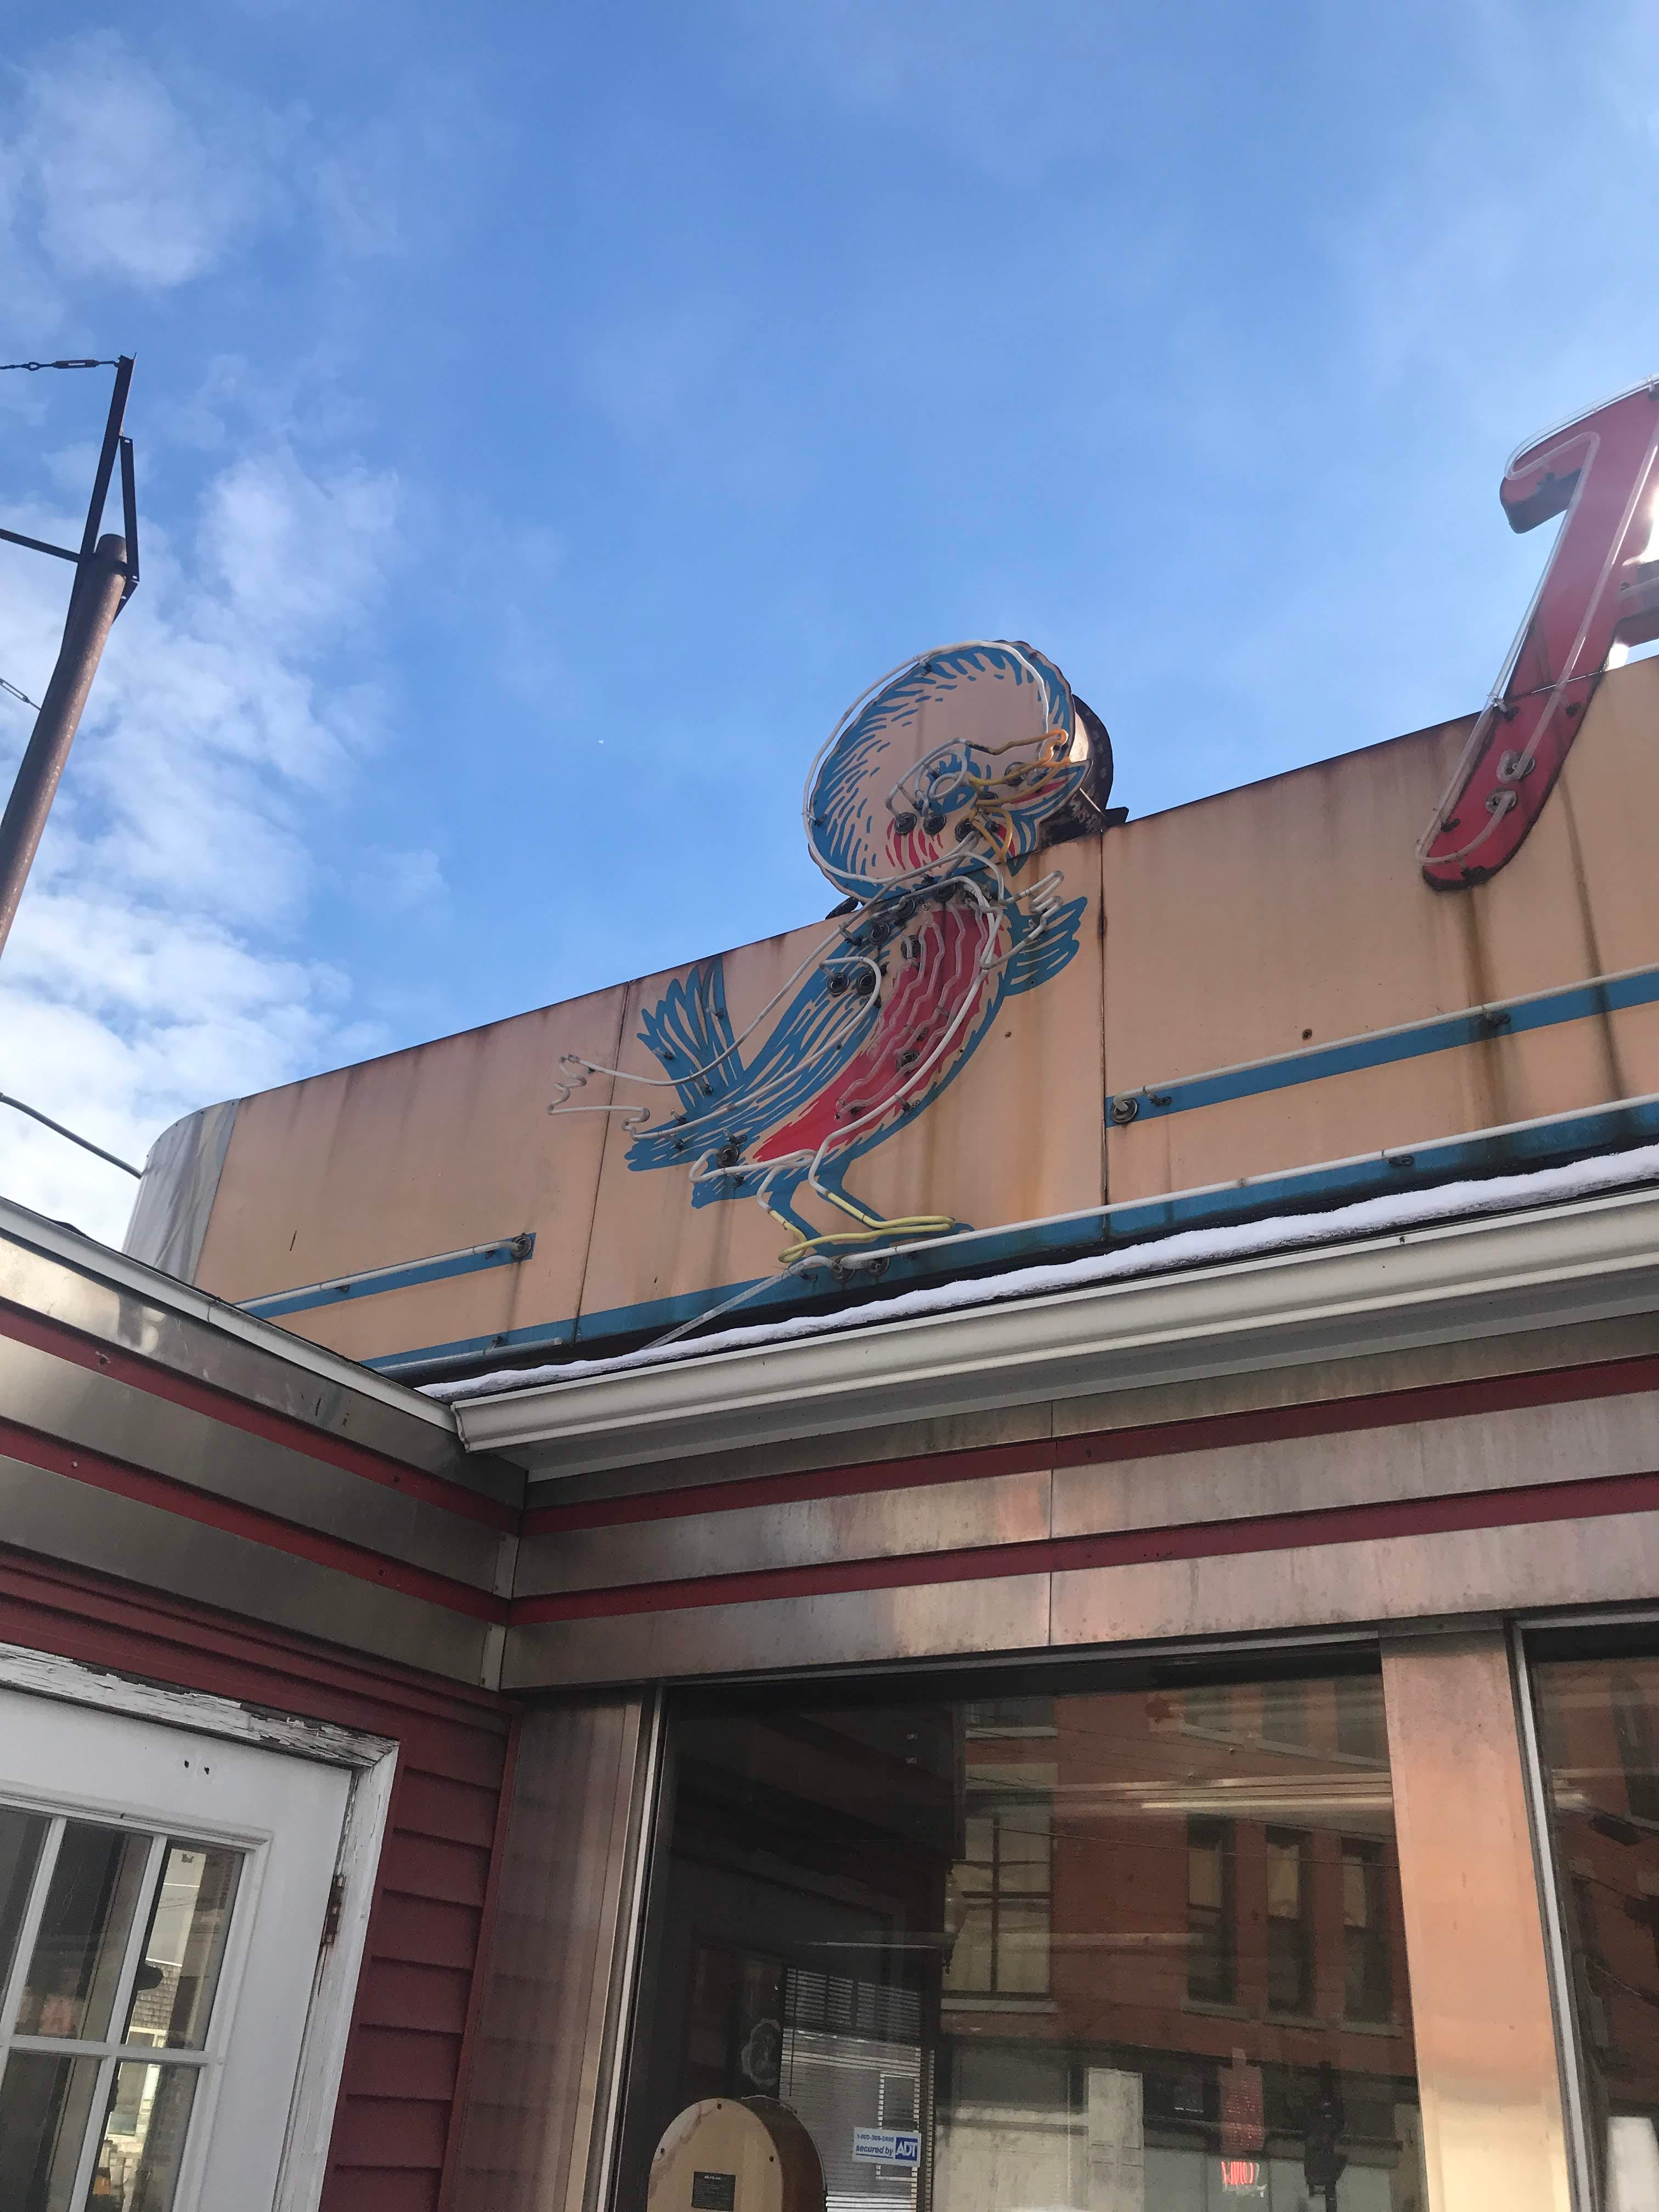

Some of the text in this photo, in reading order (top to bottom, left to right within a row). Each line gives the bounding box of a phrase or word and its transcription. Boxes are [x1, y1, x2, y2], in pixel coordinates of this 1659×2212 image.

[856, 2145, 893, 2156] secured by
[896, 2141, 918, 2157] ADT
